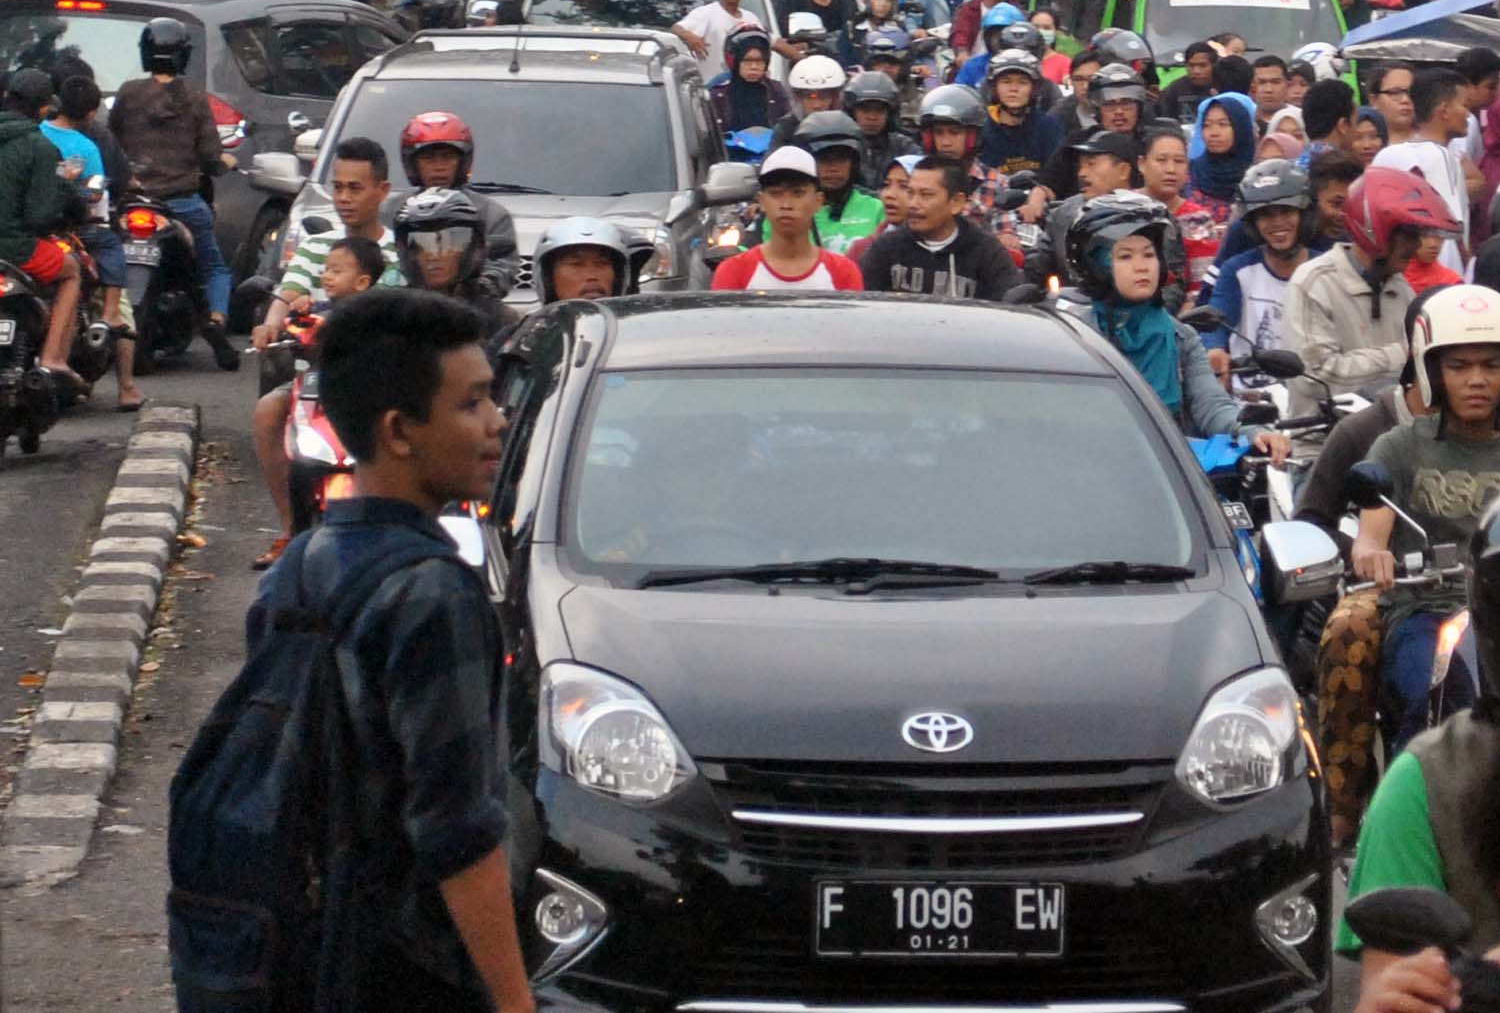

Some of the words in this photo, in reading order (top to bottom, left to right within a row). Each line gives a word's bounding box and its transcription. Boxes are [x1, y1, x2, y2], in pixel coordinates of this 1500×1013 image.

[823, 887, 844, 928] F
[893, 888, 973, 929] 1096
[1016, 888, 1060, 929] EW
